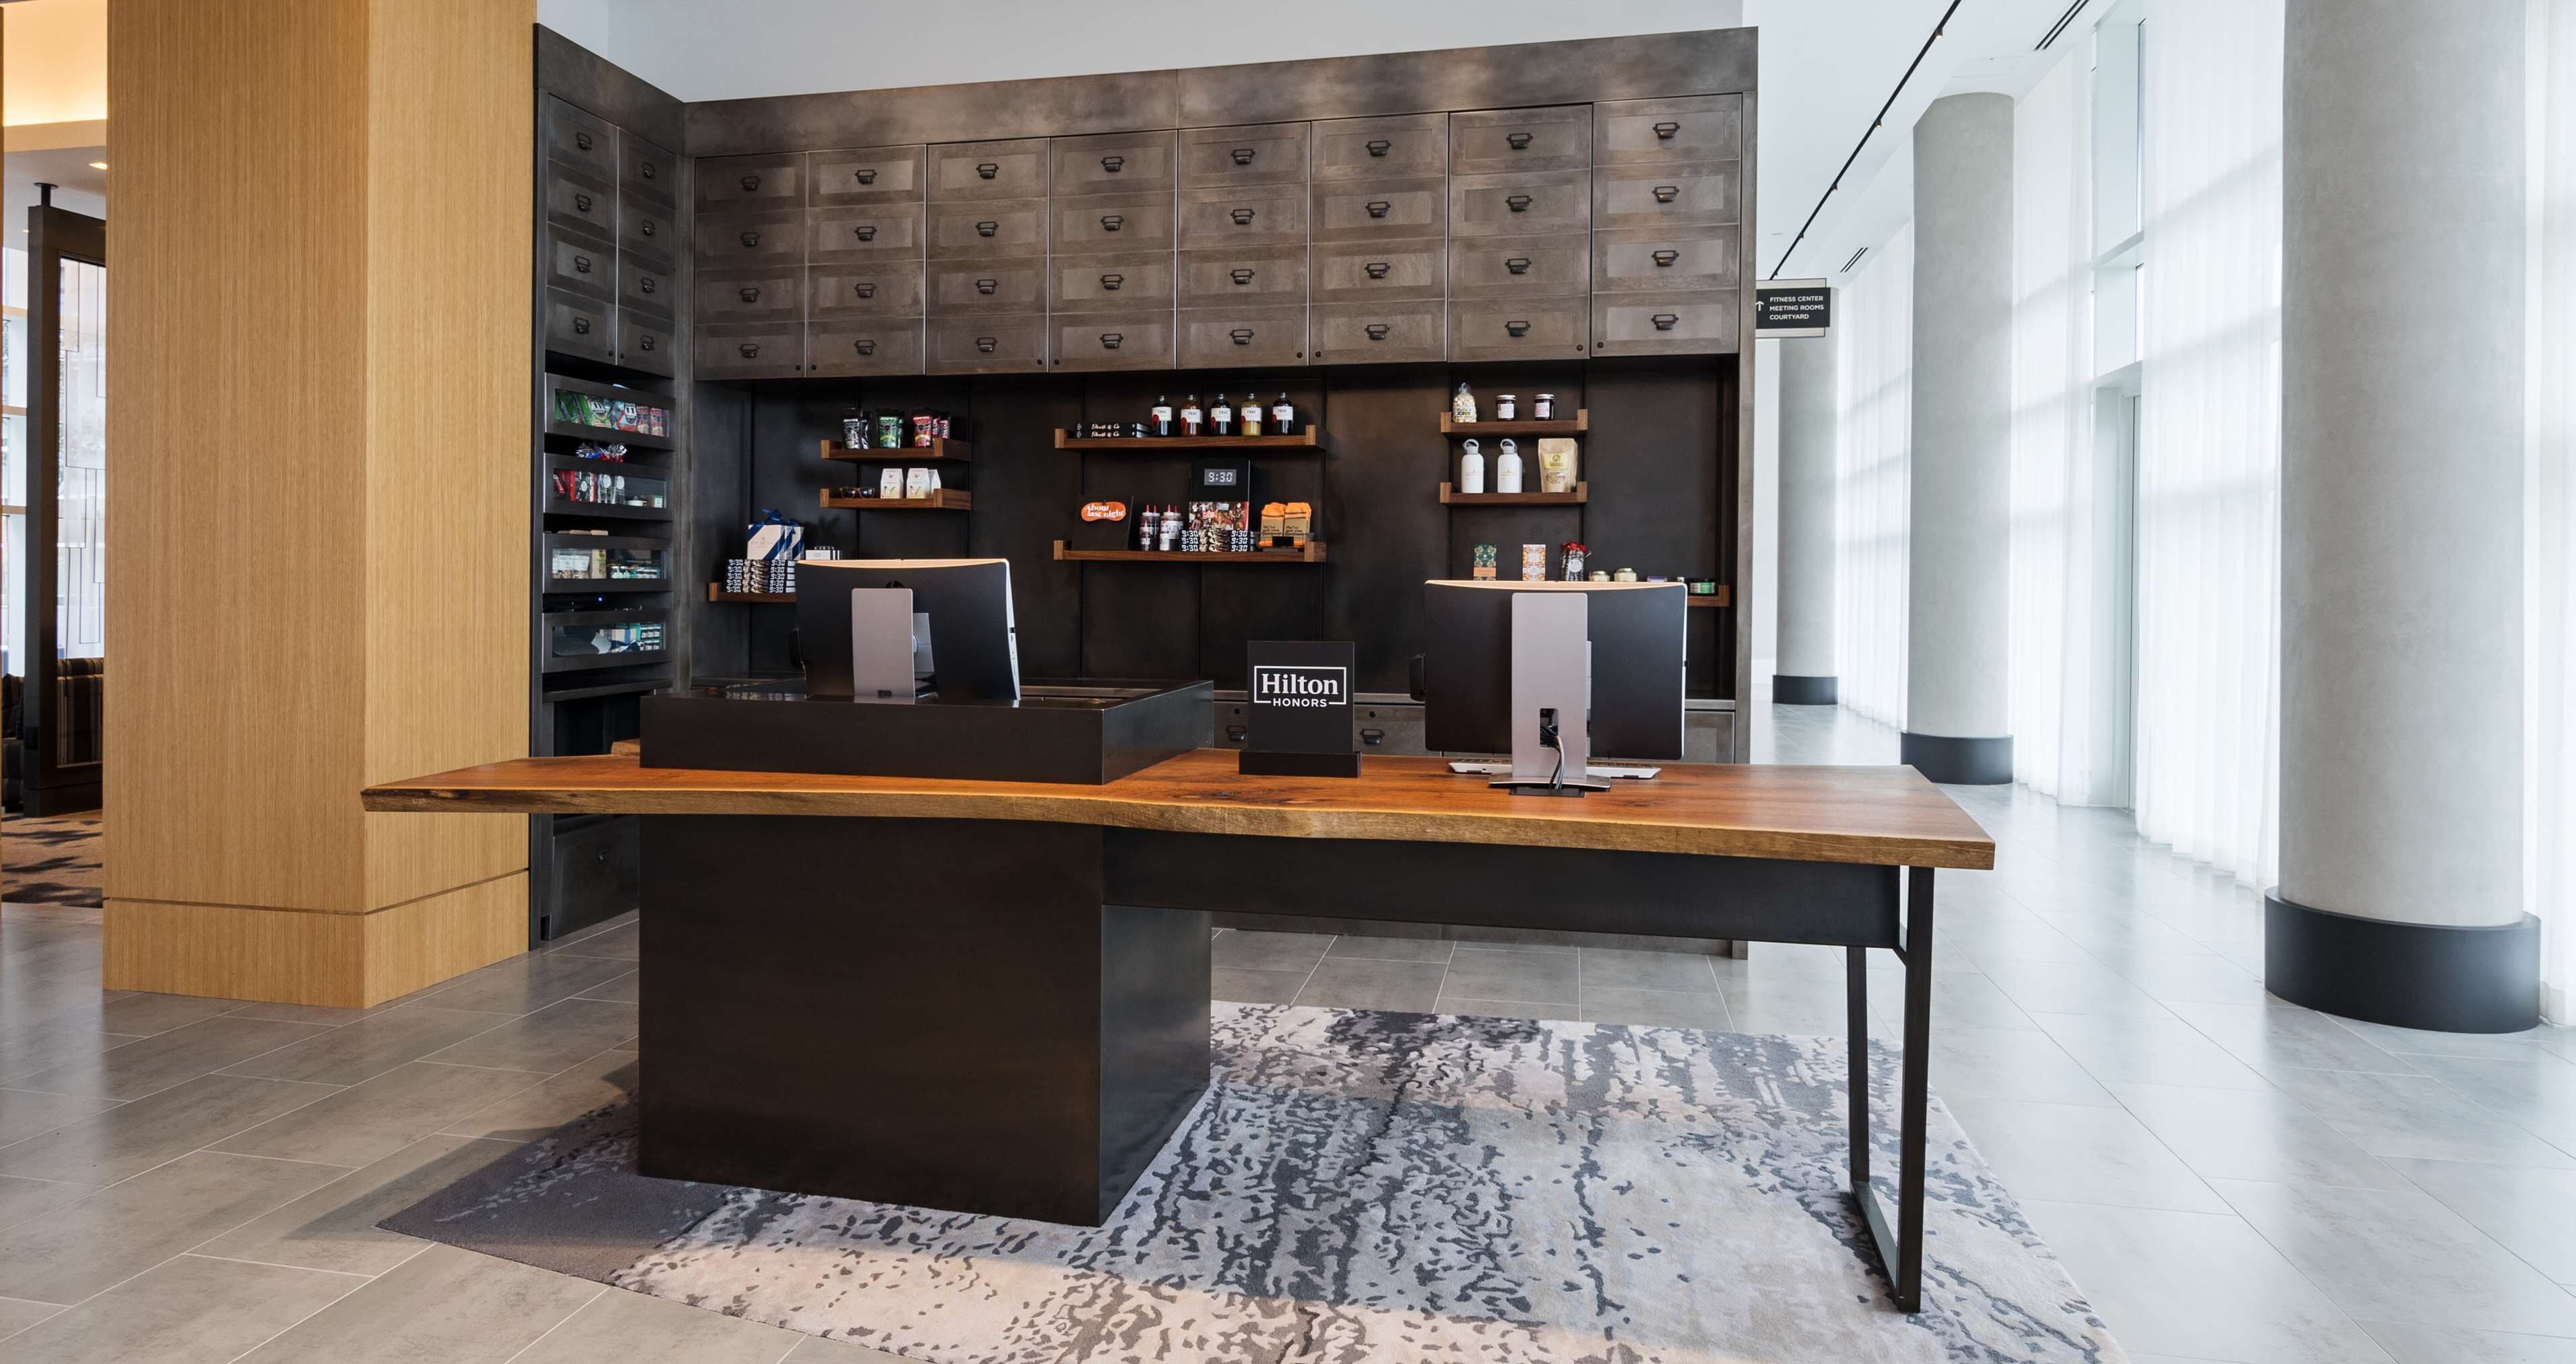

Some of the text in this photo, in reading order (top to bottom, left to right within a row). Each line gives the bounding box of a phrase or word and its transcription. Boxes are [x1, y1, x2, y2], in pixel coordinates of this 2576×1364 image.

[1208, 472, 1233, 482] 9:30
[1261, 673, 1338, 695] Hilton
[1273, 698, 1328, 708] HONORS
